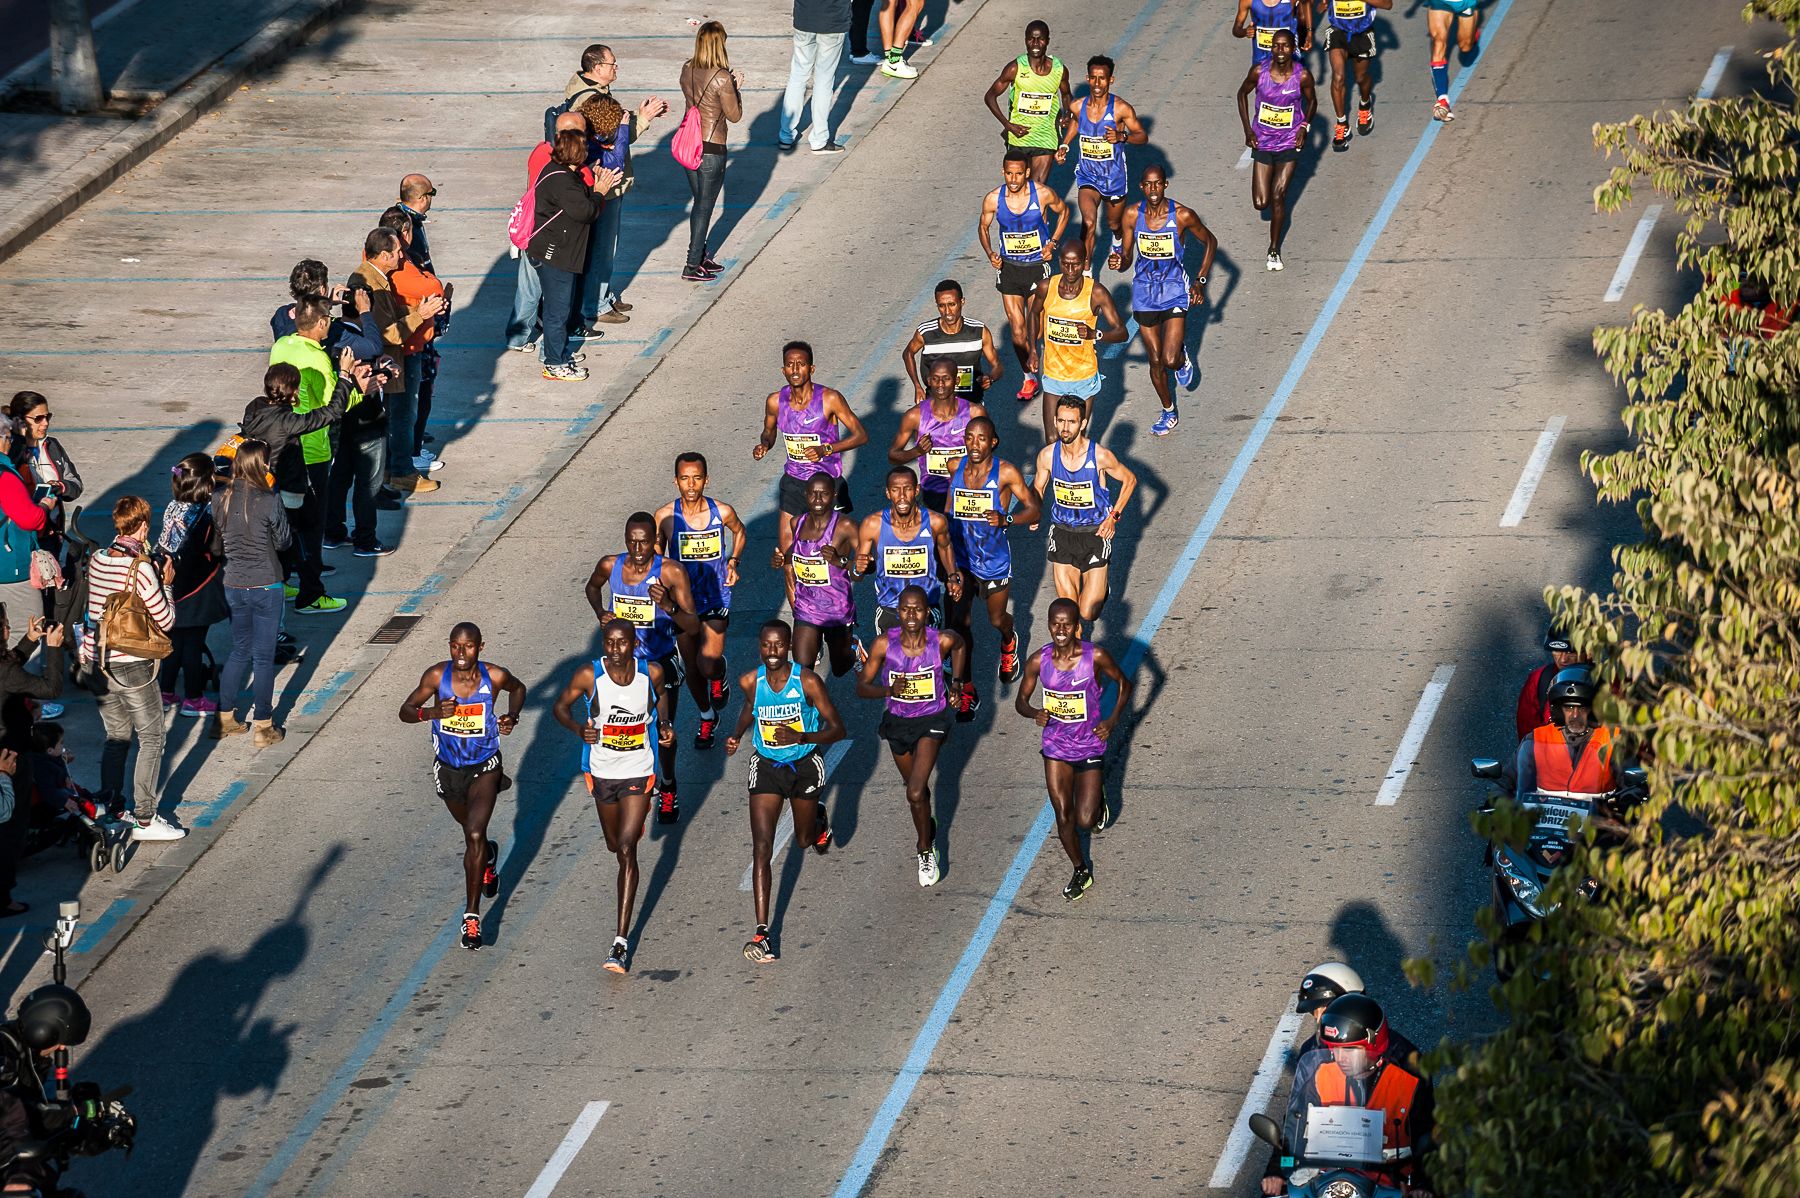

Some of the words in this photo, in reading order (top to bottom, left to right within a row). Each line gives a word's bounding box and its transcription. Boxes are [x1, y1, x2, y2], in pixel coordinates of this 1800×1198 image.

[621, 612, 644, 620] KISORIO
[758, 702, 801, 718] RUNCZECH
[612, 727, 637, 735] PACE
